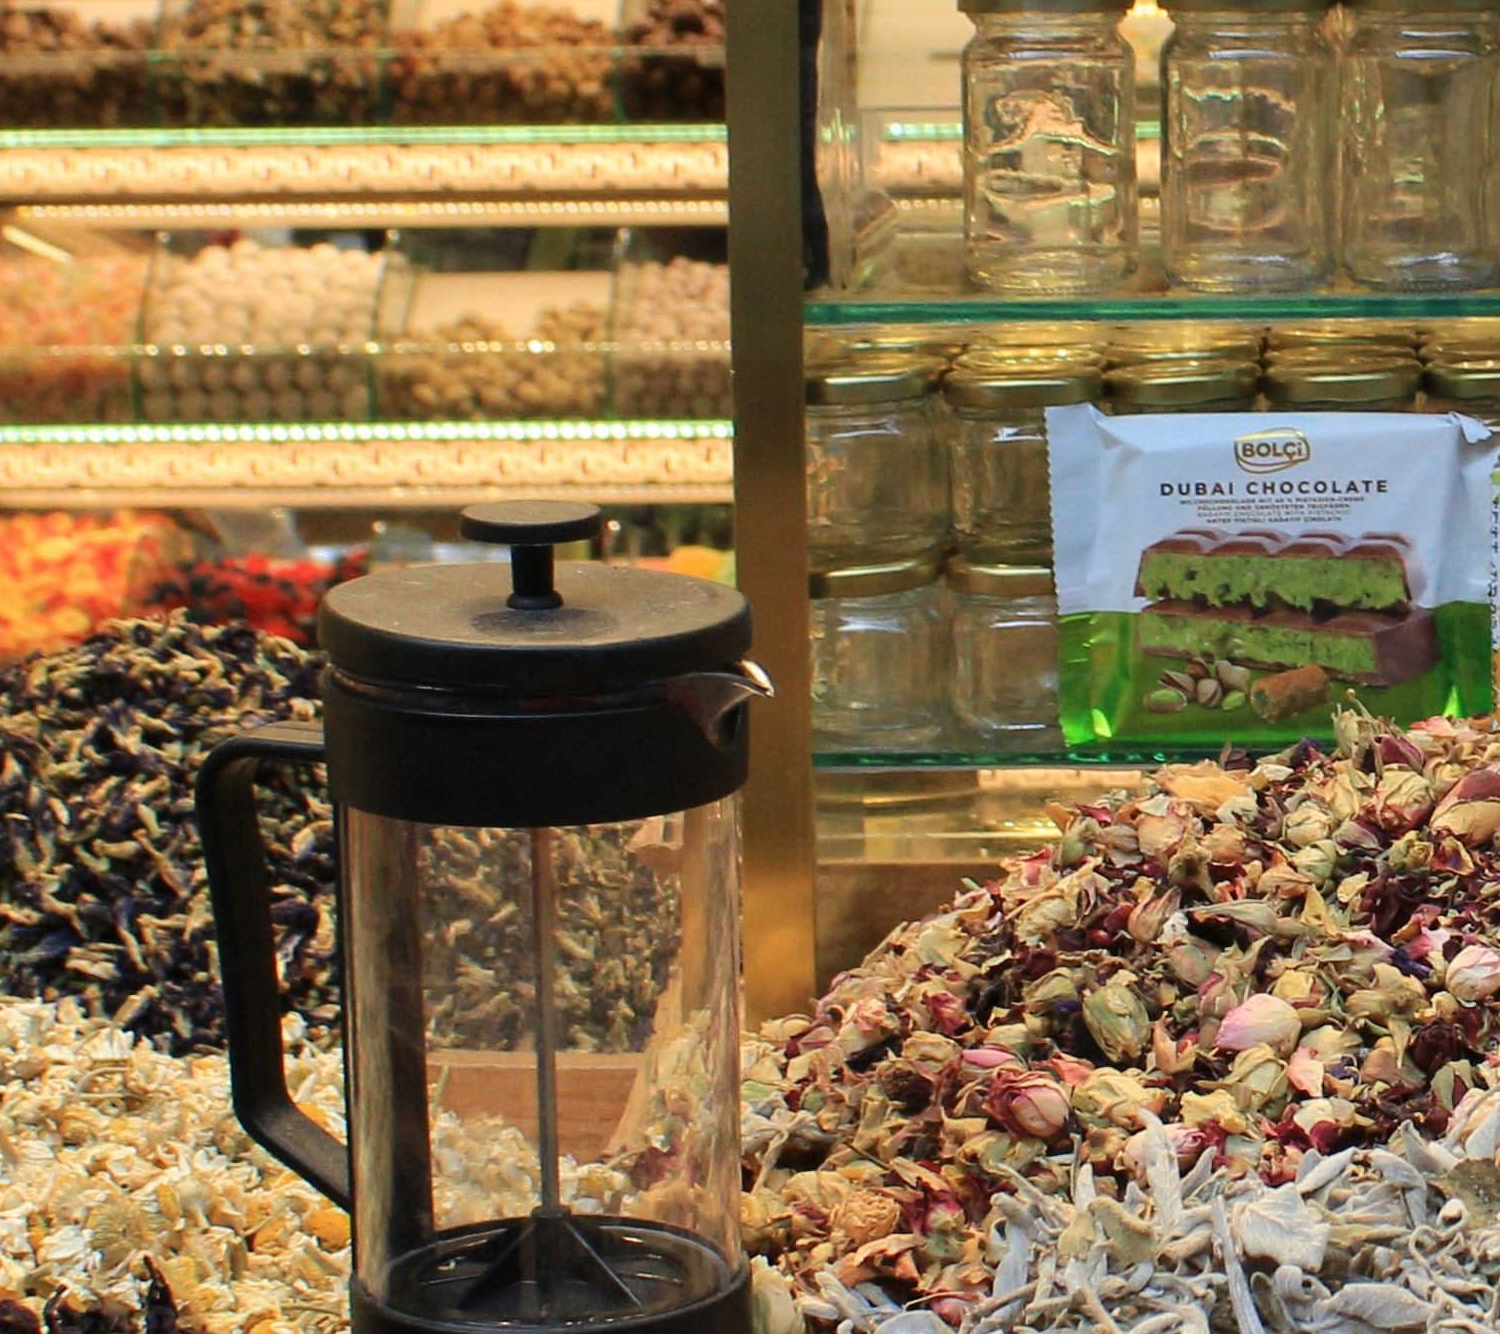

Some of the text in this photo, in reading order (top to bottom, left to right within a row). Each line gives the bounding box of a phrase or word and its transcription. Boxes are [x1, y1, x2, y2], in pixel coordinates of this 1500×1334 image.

[1241, 441, 1303, 461] BOLÇi
[1160, 479, 1390, 497] DUBAI CHOCOLATE
